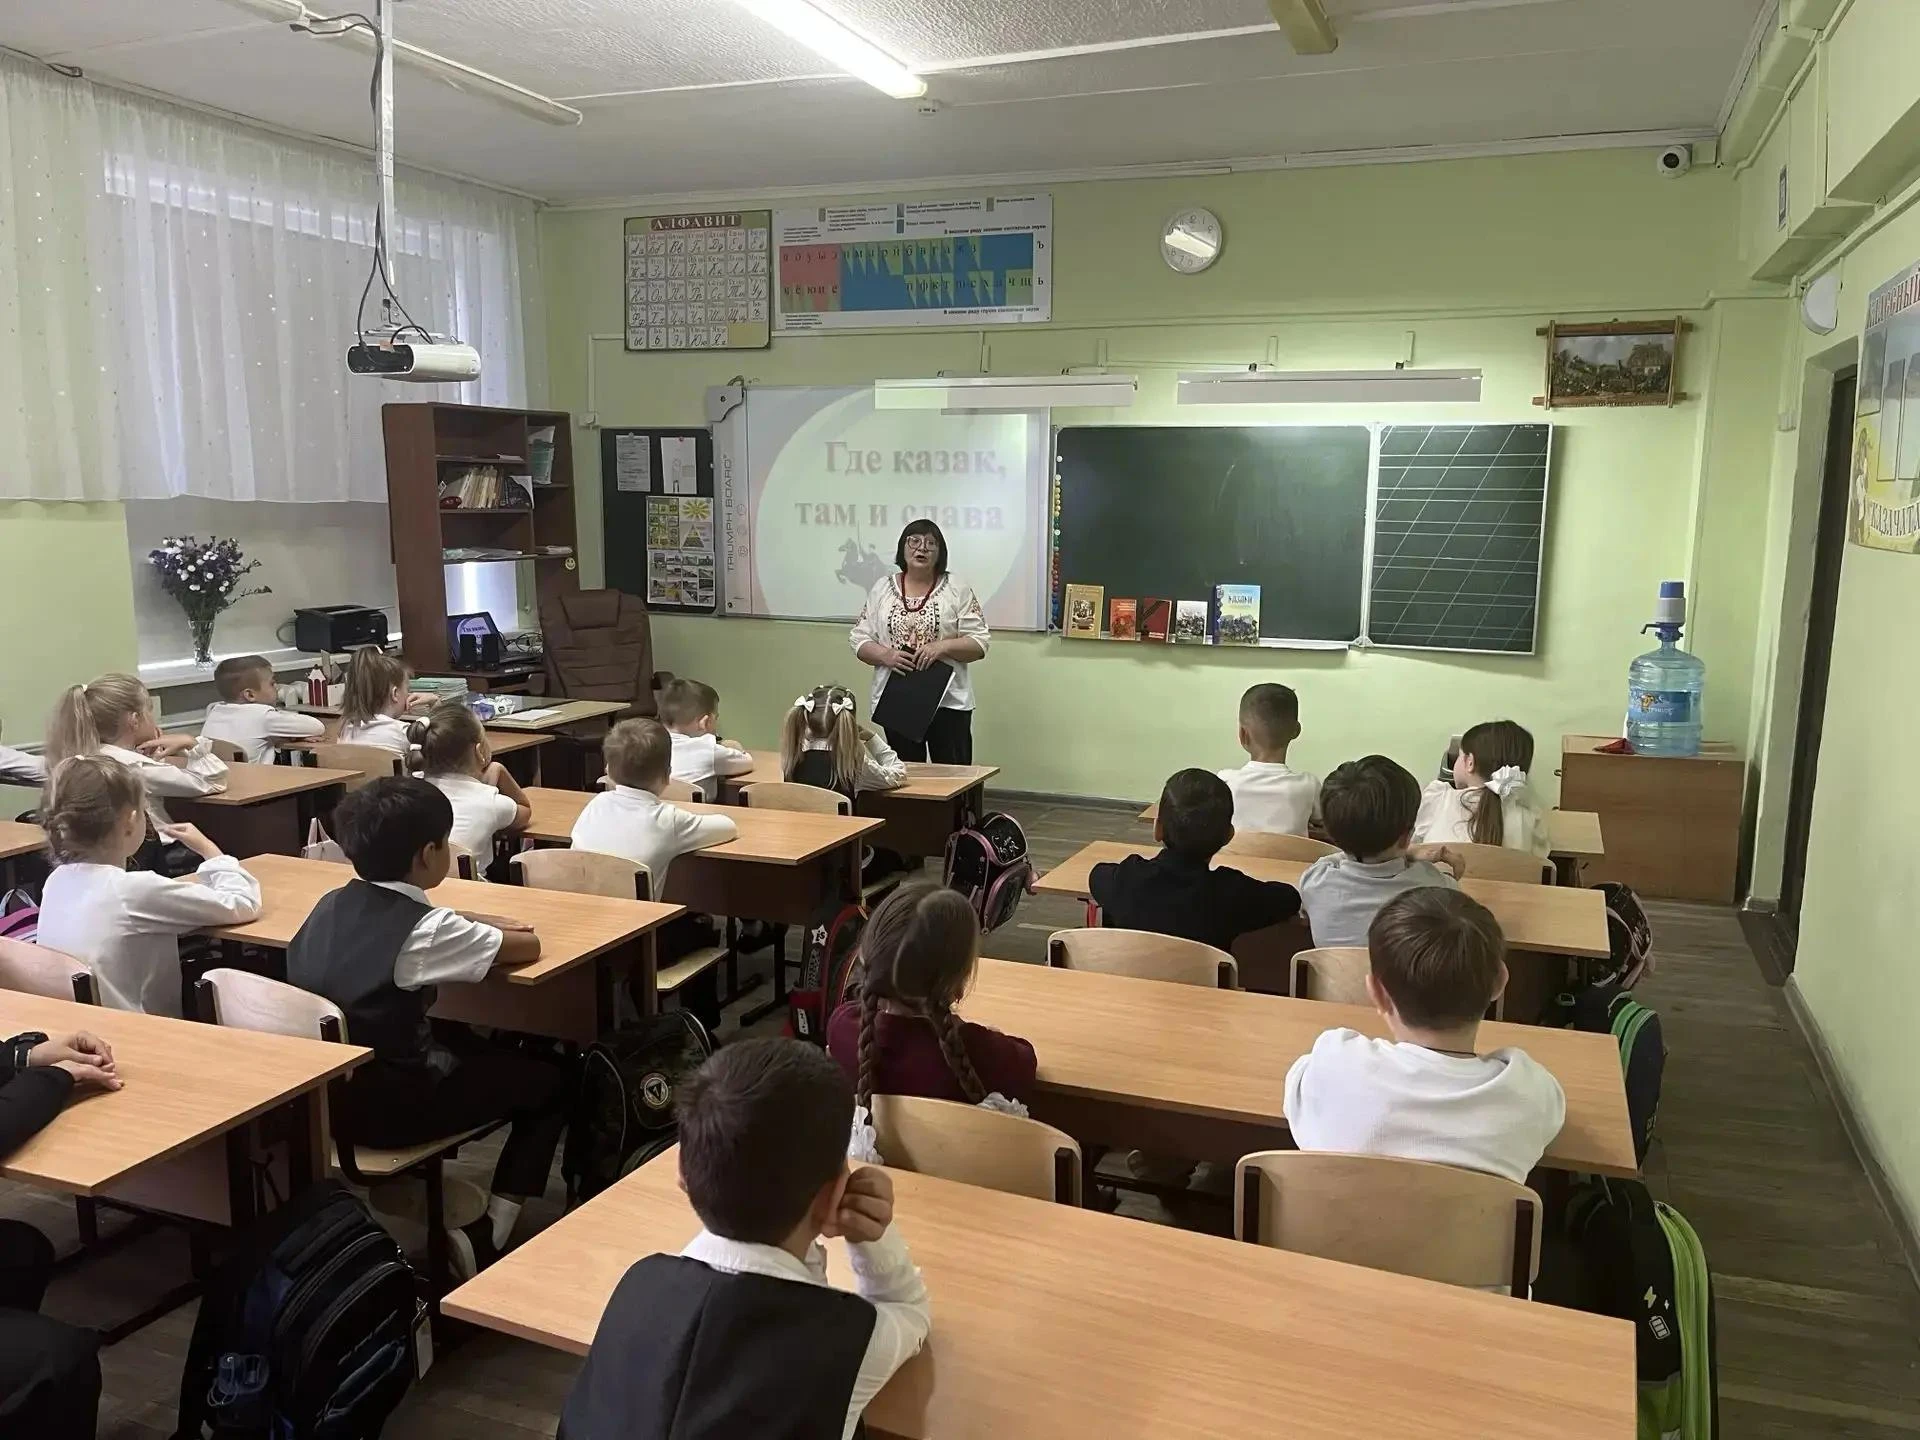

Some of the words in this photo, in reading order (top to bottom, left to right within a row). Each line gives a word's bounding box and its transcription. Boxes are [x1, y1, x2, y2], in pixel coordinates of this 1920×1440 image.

[654, 214, 738, 230] АЛФАВИТ
[825, 441, 883, 476] Где
[892, 448, 1006, 478] казак,
[795, 502, 857, 526] там
[868, 504, 888, 527] и
